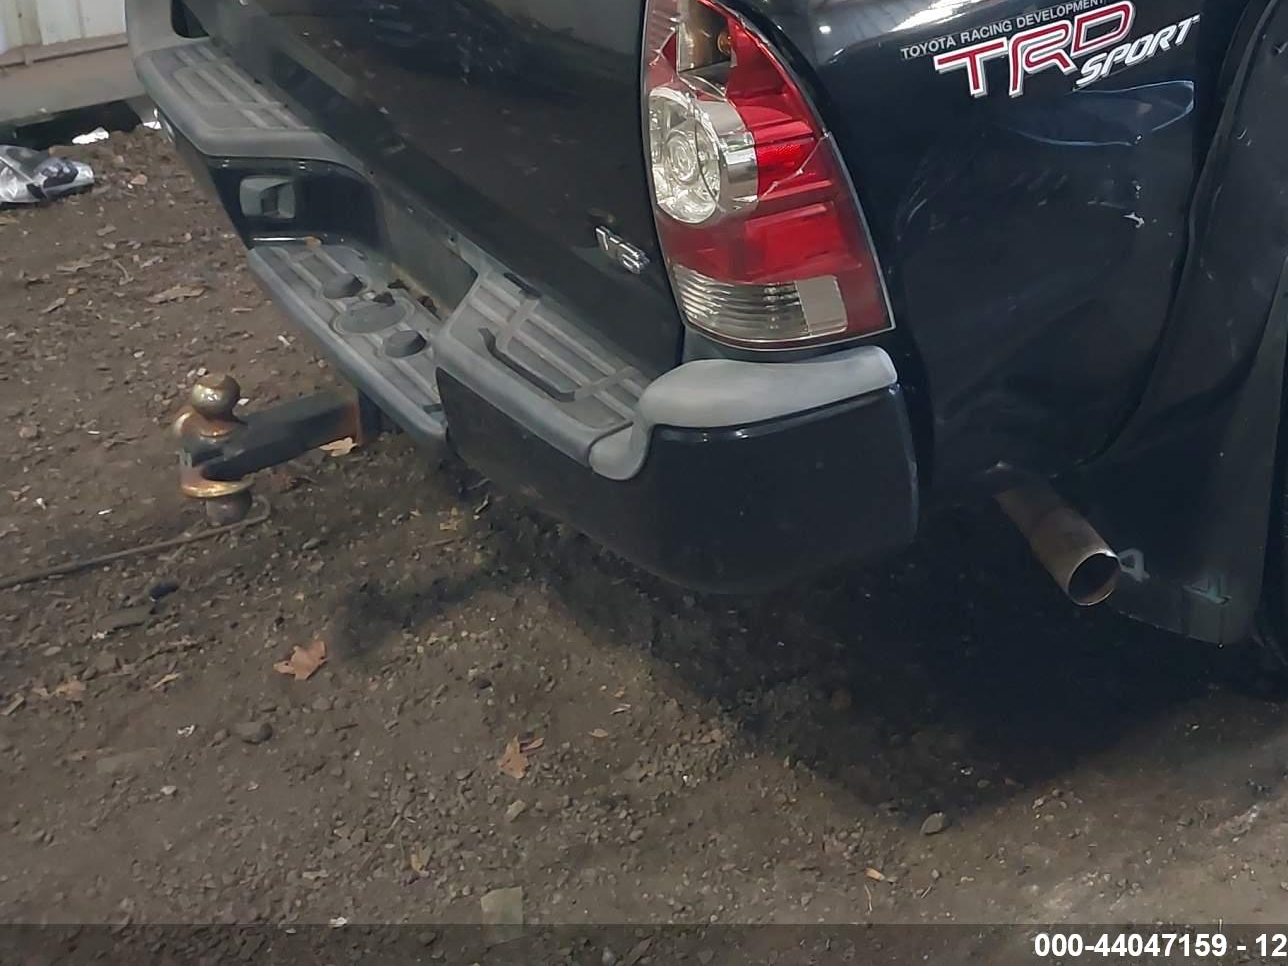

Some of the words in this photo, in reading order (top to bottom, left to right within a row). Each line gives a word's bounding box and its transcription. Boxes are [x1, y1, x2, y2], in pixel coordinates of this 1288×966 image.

[901, 35, 957, 60] TOYOTA
[960, 17, 1013, 44] RACING
[934, 0, 1137, 99] TRD
[1072, 14, 1201, 92] SPORT
[592, 223, 650, 275] V6
